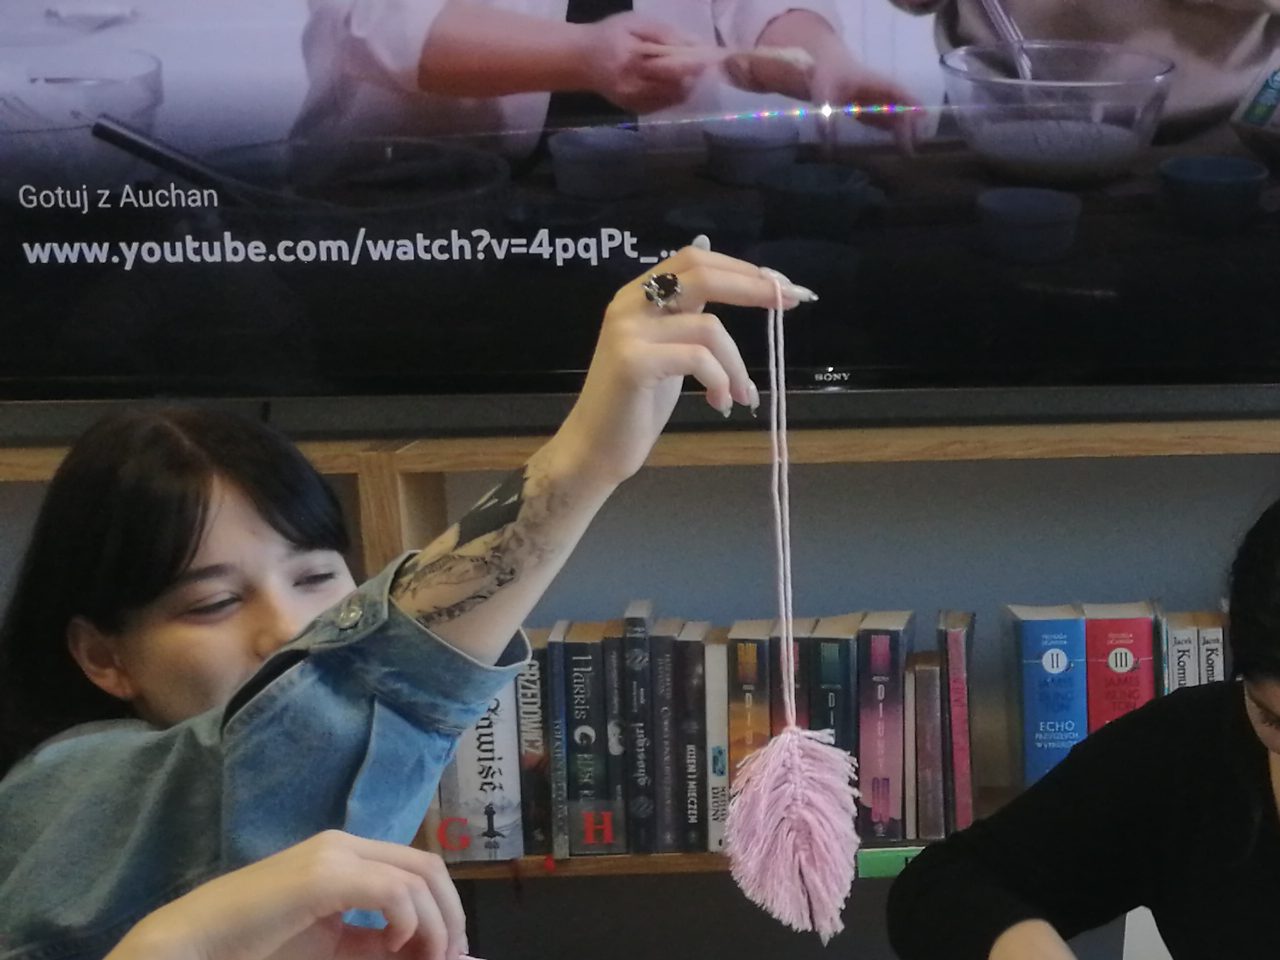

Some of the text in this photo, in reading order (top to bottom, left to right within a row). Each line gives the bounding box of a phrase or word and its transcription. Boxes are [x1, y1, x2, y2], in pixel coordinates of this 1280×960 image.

[18, 182, 219, 214] Gotuj z Auchan
[814, 372, 851, 382] SONY
[1172, 636, 1193, 648] Jacek
[1201, 635, 1222, 647] Jacek
[1113, 651, 1129, 668] III
[1176, 648, 1192, 687] Komu
[1205, 647, 1219, 683] Komu
[1039, 720, 1075, 732] ECHO
[630, 722, 650, 786] ghostgirl
[687, 781, 698, 824] MIECZEM
[437, 816, 472, 852] G
[581, 810, 616, 845] H
